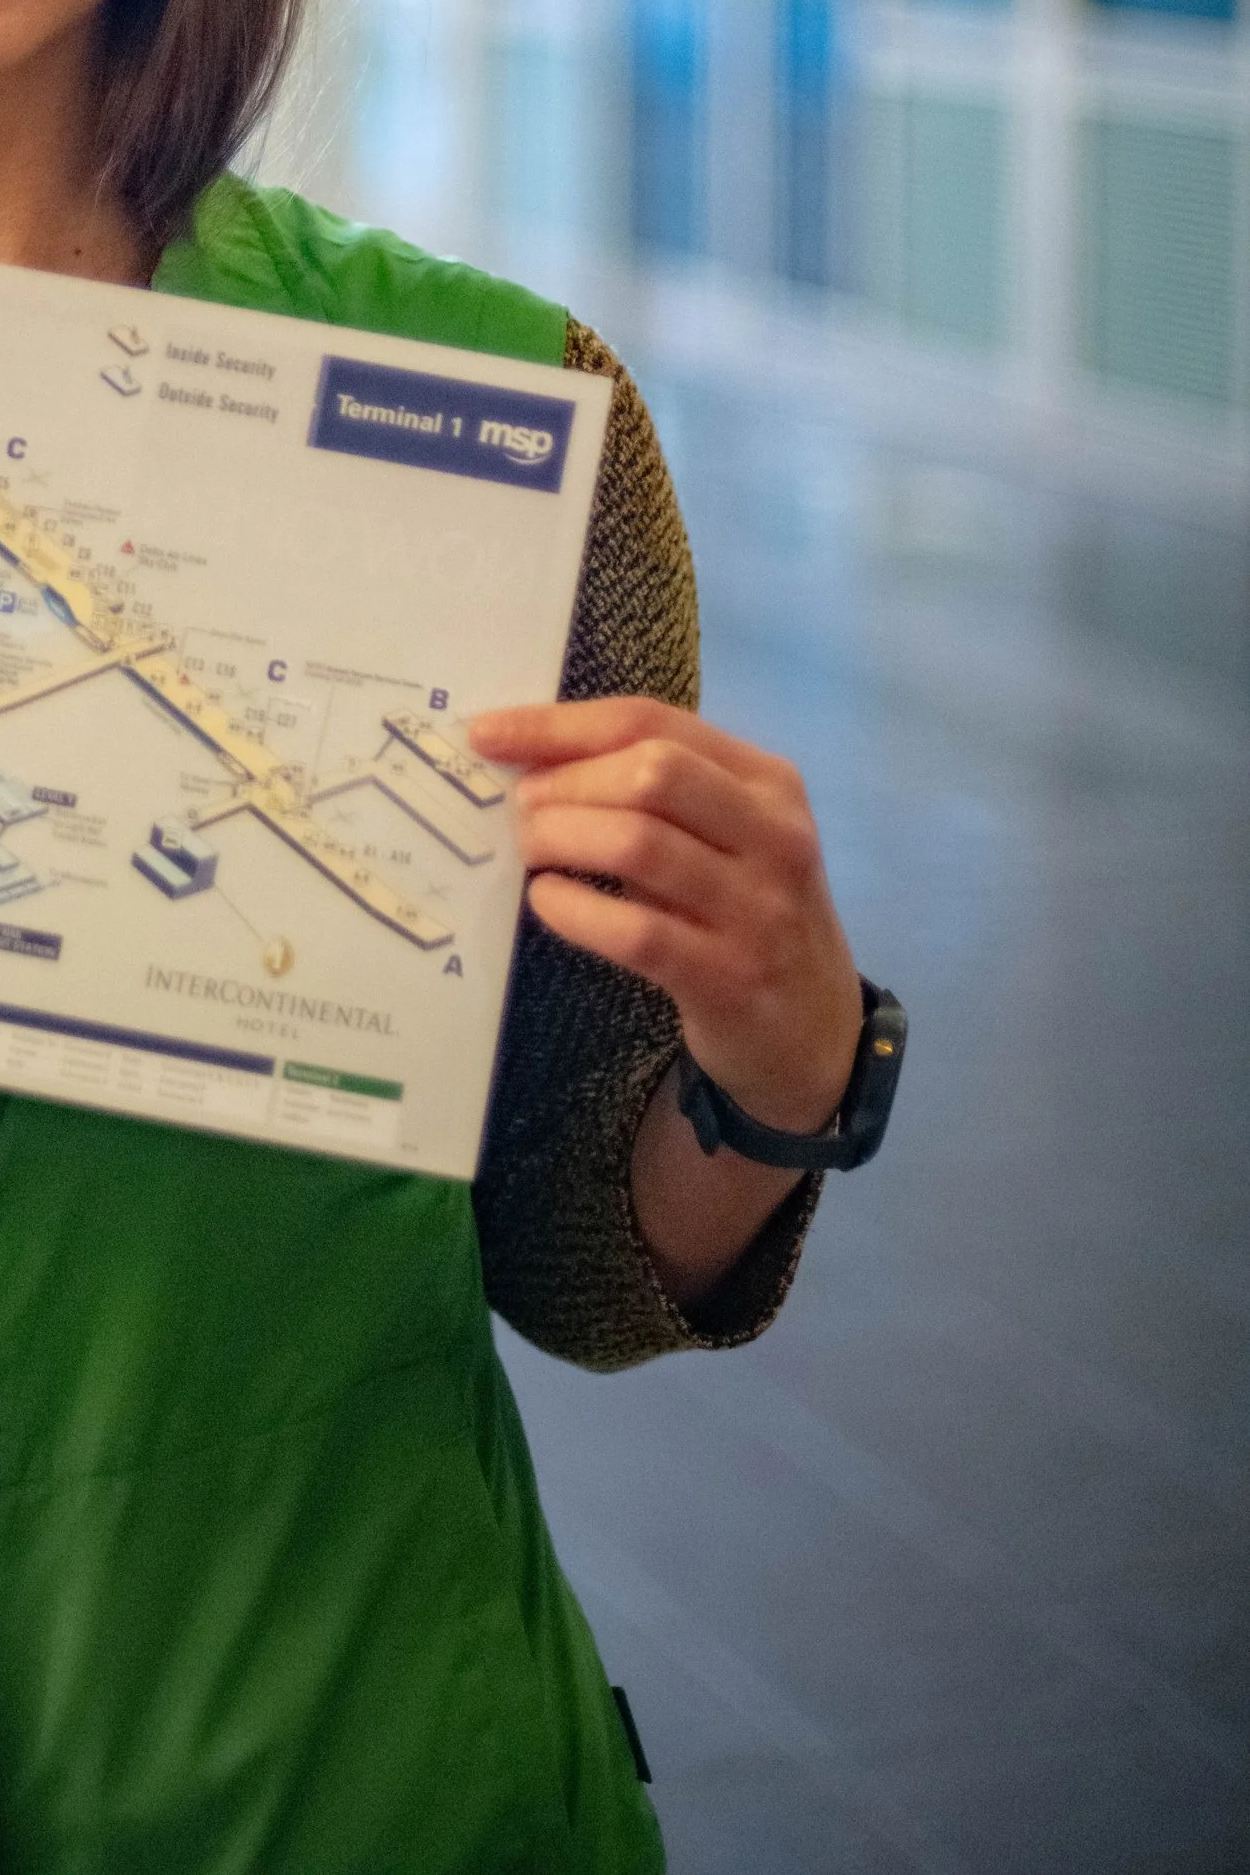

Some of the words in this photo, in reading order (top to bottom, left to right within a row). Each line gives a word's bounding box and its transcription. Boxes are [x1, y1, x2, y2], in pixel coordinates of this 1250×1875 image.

[165, 341, 210, 367] Inside
[216, 351, 277, 381] Security
[158, 381, 215, 409] Outside
[218, 393, 280, 424] Security
[337, 393, 443, 434] Terminal
[451, 416, 463, 438] 1
[478, 418, 554, 458] msp
[7, 437, 28, 460] C
[268, 659, 288, 682] C
[429, 687, 450, 710] B
[443, 954, 465, 979] A
[236, 1016, 301, 1041] HOTEL
